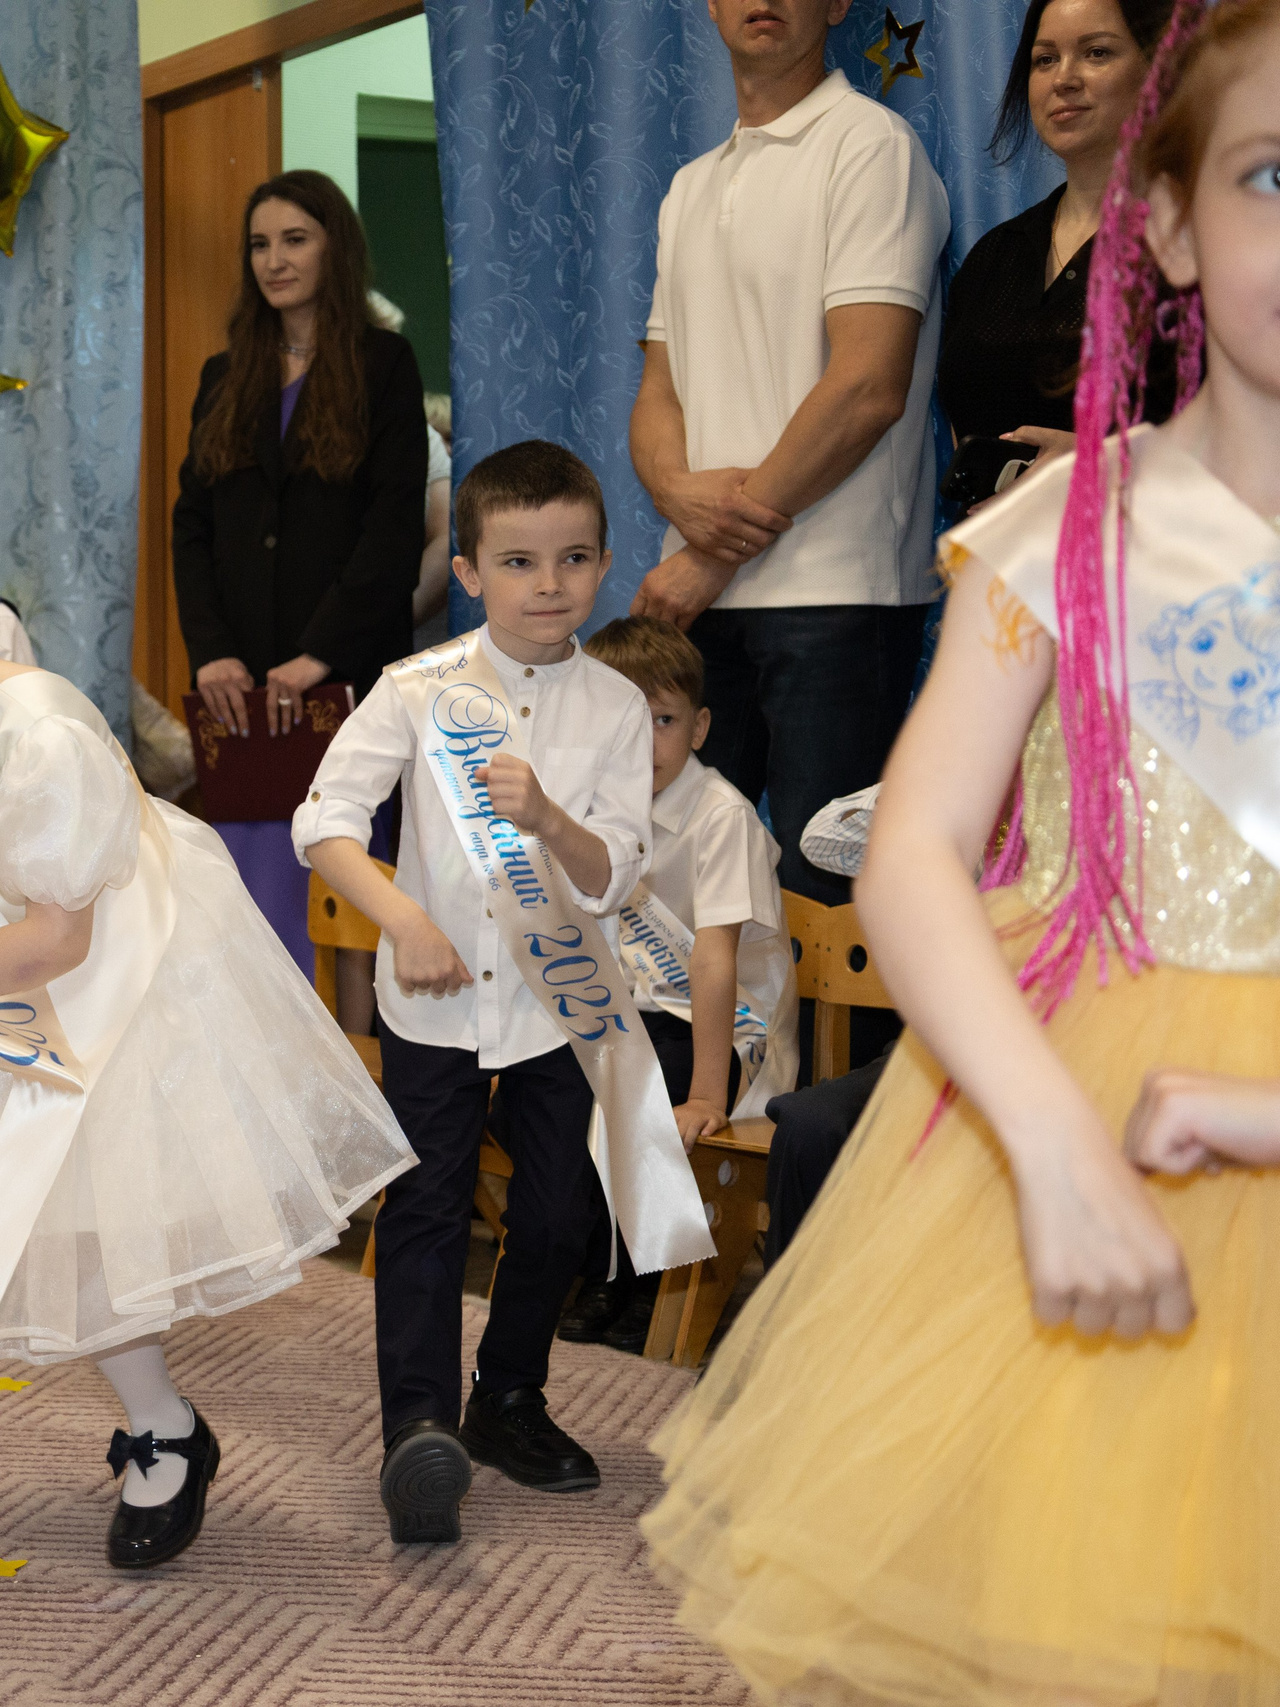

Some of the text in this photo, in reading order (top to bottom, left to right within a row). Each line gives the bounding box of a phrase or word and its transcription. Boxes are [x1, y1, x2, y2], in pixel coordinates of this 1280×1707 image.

[468, 831, 486, 861] сада
[488, 876, 501, 891] 66
[531, 830, 553, 876] тепан
[523, 925, 629, 1041] 2025
